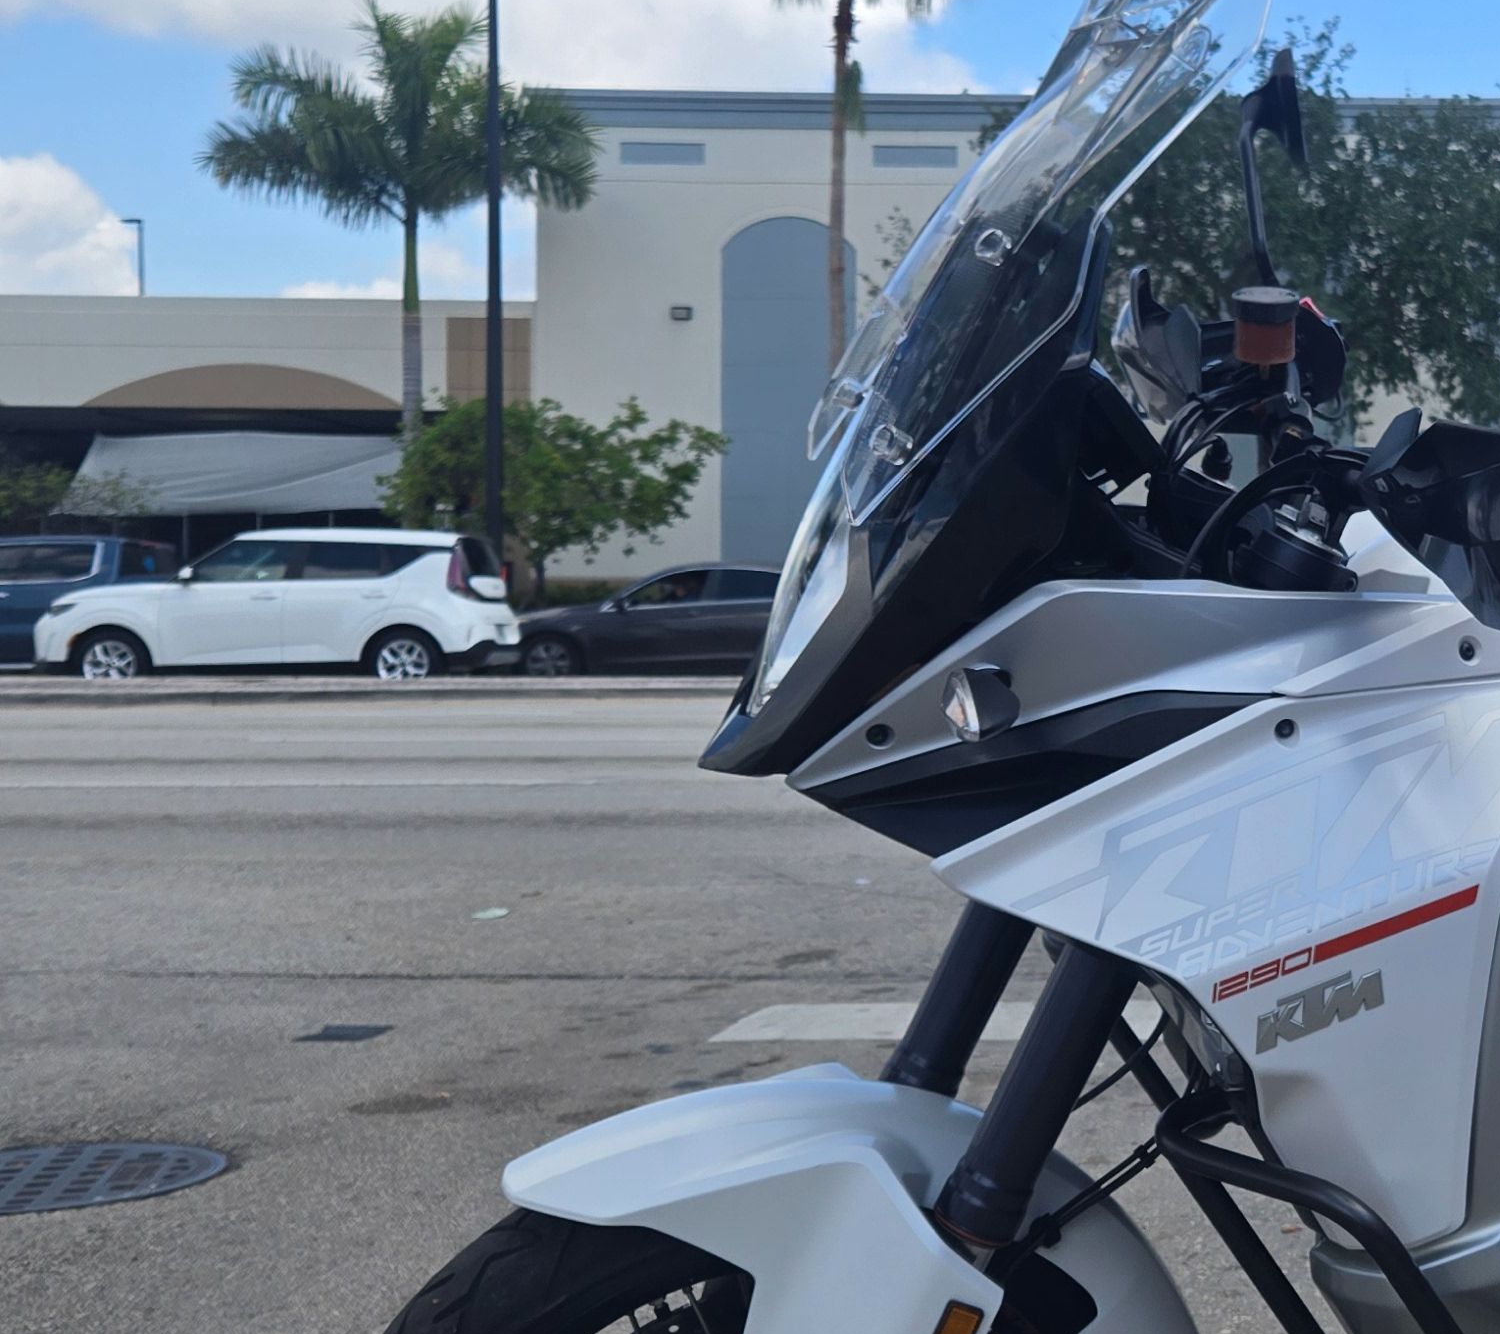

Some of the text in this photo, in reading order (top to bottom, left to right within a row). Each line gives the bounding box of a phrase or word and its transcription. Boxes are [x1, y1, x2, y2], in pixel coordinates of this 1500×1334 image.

[1138, 873, 1305, 961] SUPER
[1175, 837, 1500, 981] ADVENTURE
[1212, 946, 1314, 1004] 1290
[1255, 967, 1385, 1055] KTM
